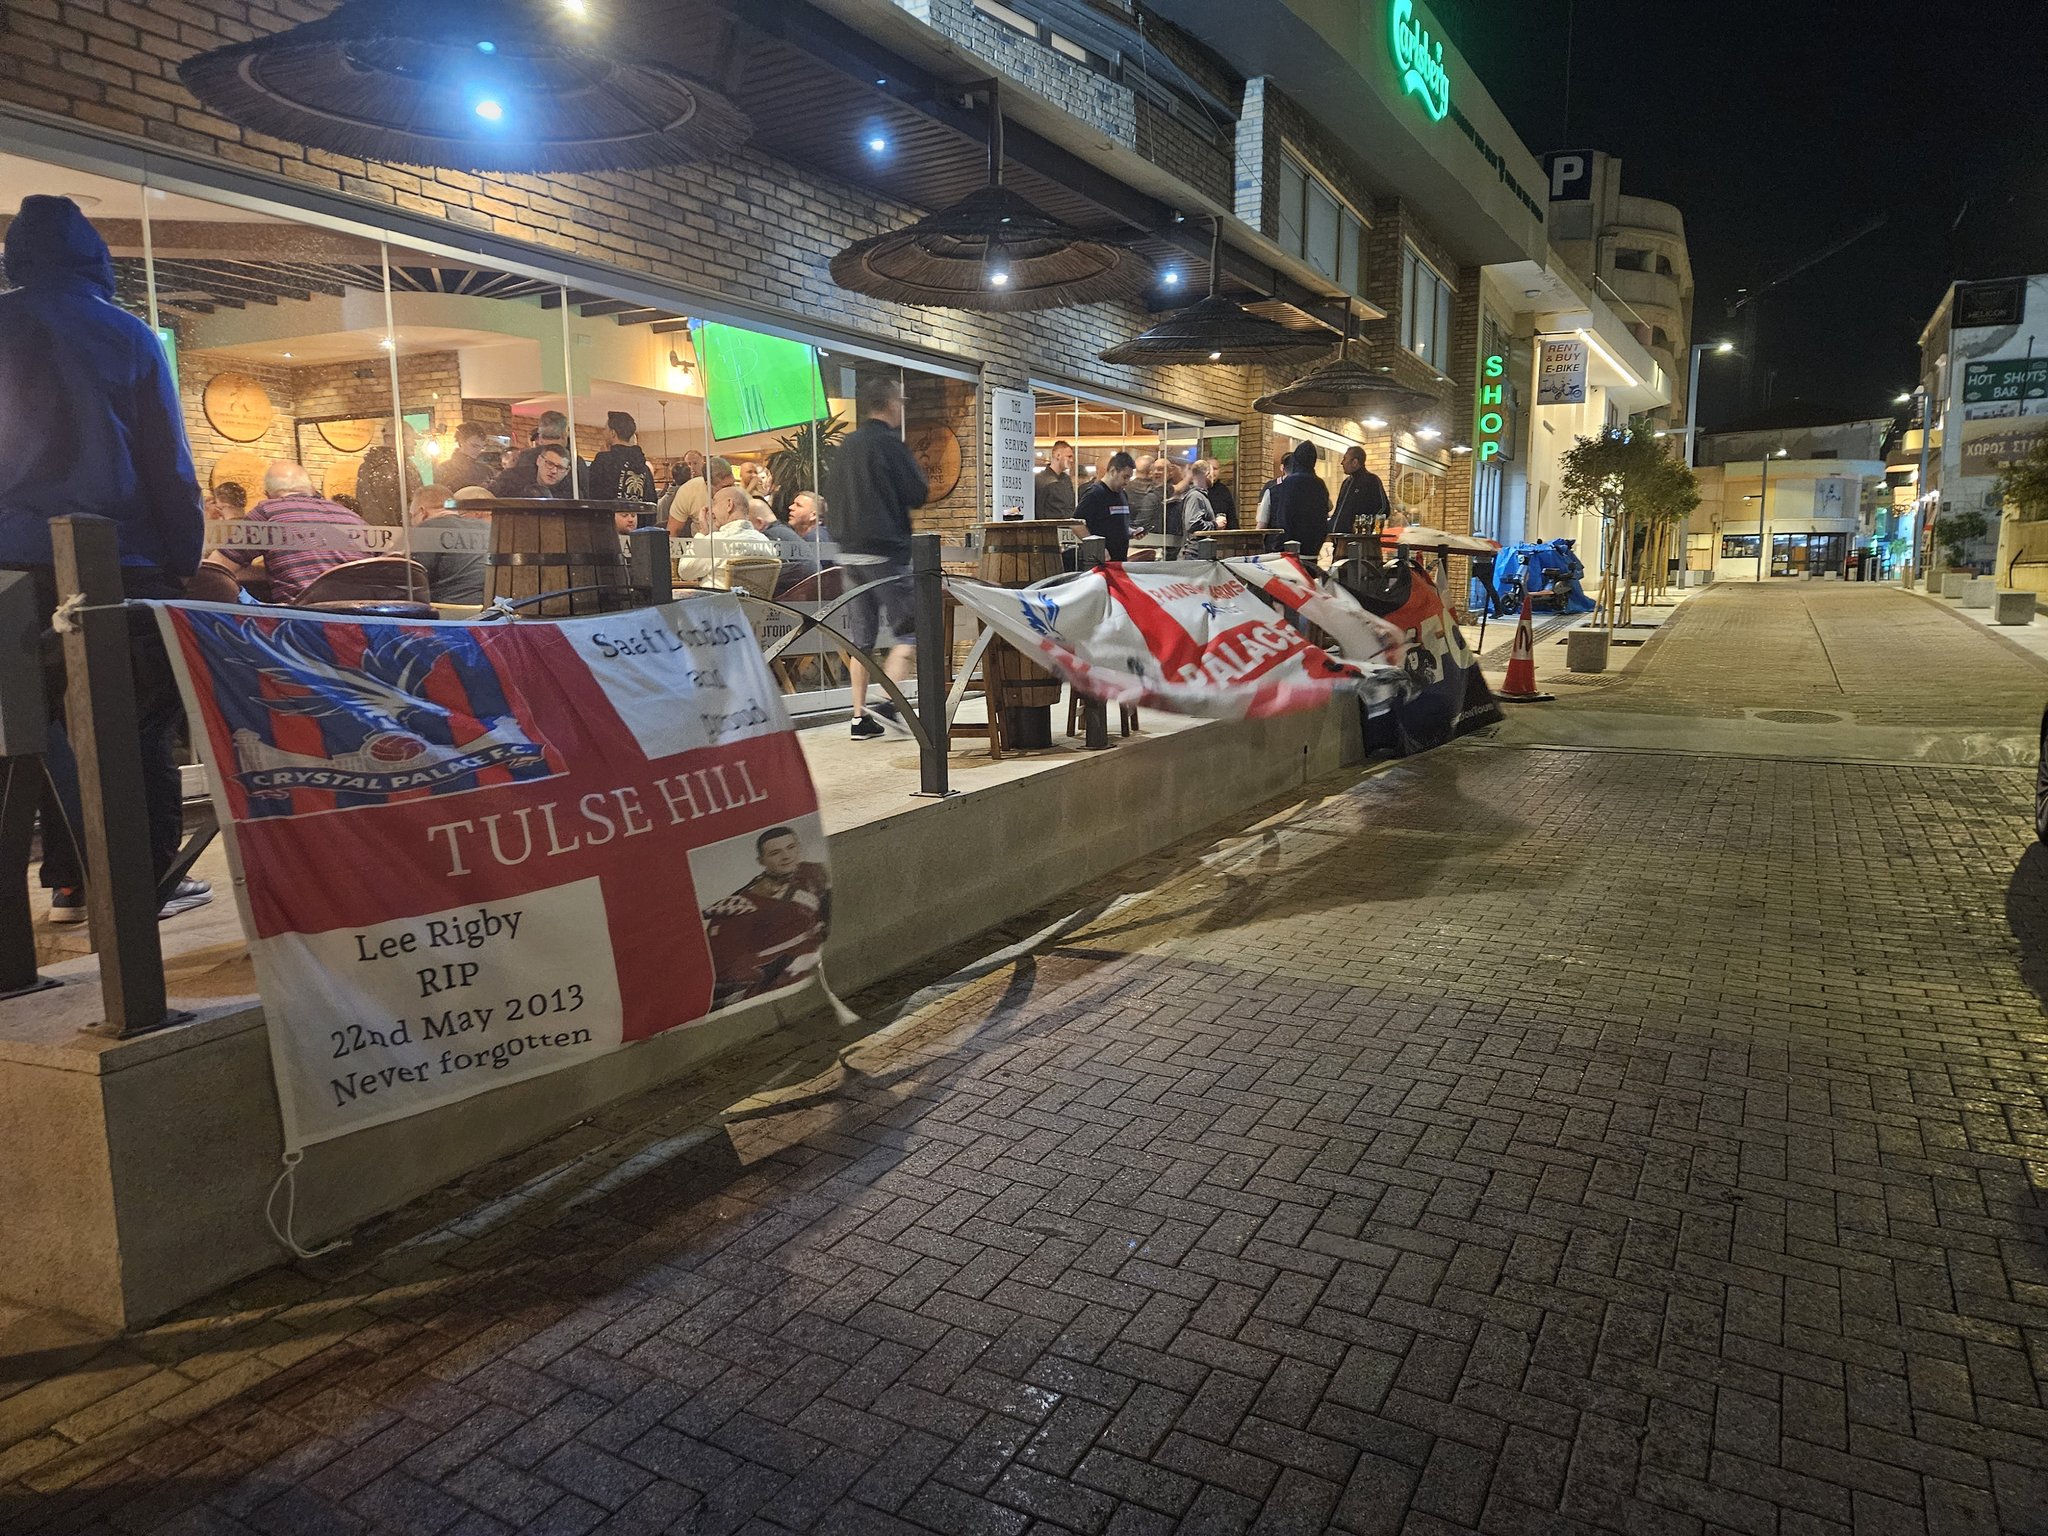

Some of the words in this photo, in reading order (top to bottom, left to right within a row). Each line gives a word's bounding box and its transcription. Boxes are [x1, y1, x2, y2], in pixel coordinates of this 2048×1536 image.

[1393, 0, 1450, 121] Carlsberg
[1552, 156, 1584, 197] P
[1547, 343, 1580, 353] RENT
[1555, 353, 1581, 362] BUY
[1545, 363, 1581, 373] E-BIKE
[1967, 373, 1997, 386] HOT
[2003, 370, 2047, 385] SHOTS
[1993, 386, 2018, 398] BAR
[1011, 400, 1021, 414] THE
[1480, 355, 1503, 462] SHOP
[999, 417, 1022, 433] MEETING
[1022, 421, 1033, 435] PUB
[1004, 438, 1028, 453] SERVES
[1001, 456, 1031, 472] BREAKFAST
[1001, 475, 1022, 490] KEBABS
[253, 769, 382, 790] CRYSTAL
[391, 755, 489, 789] PALACE
[492, 744, 534, 760] F.C.
[427, 786, 655, 878] TULSE
[653, 760, 769, 826] HILL
[354, 931, 418, 962] Lee
[426, 908, 523, 949] Rigby
[416, 961, 480, 999] RIP
[330, 1019, 412, 1060] 22nd
[422, 1008, 494, 1041] May
[505, 983, 585, 1022] 2013
[330, 1061, 430, 1108] Never
[438, 1027, 593, 1075] forgotten
